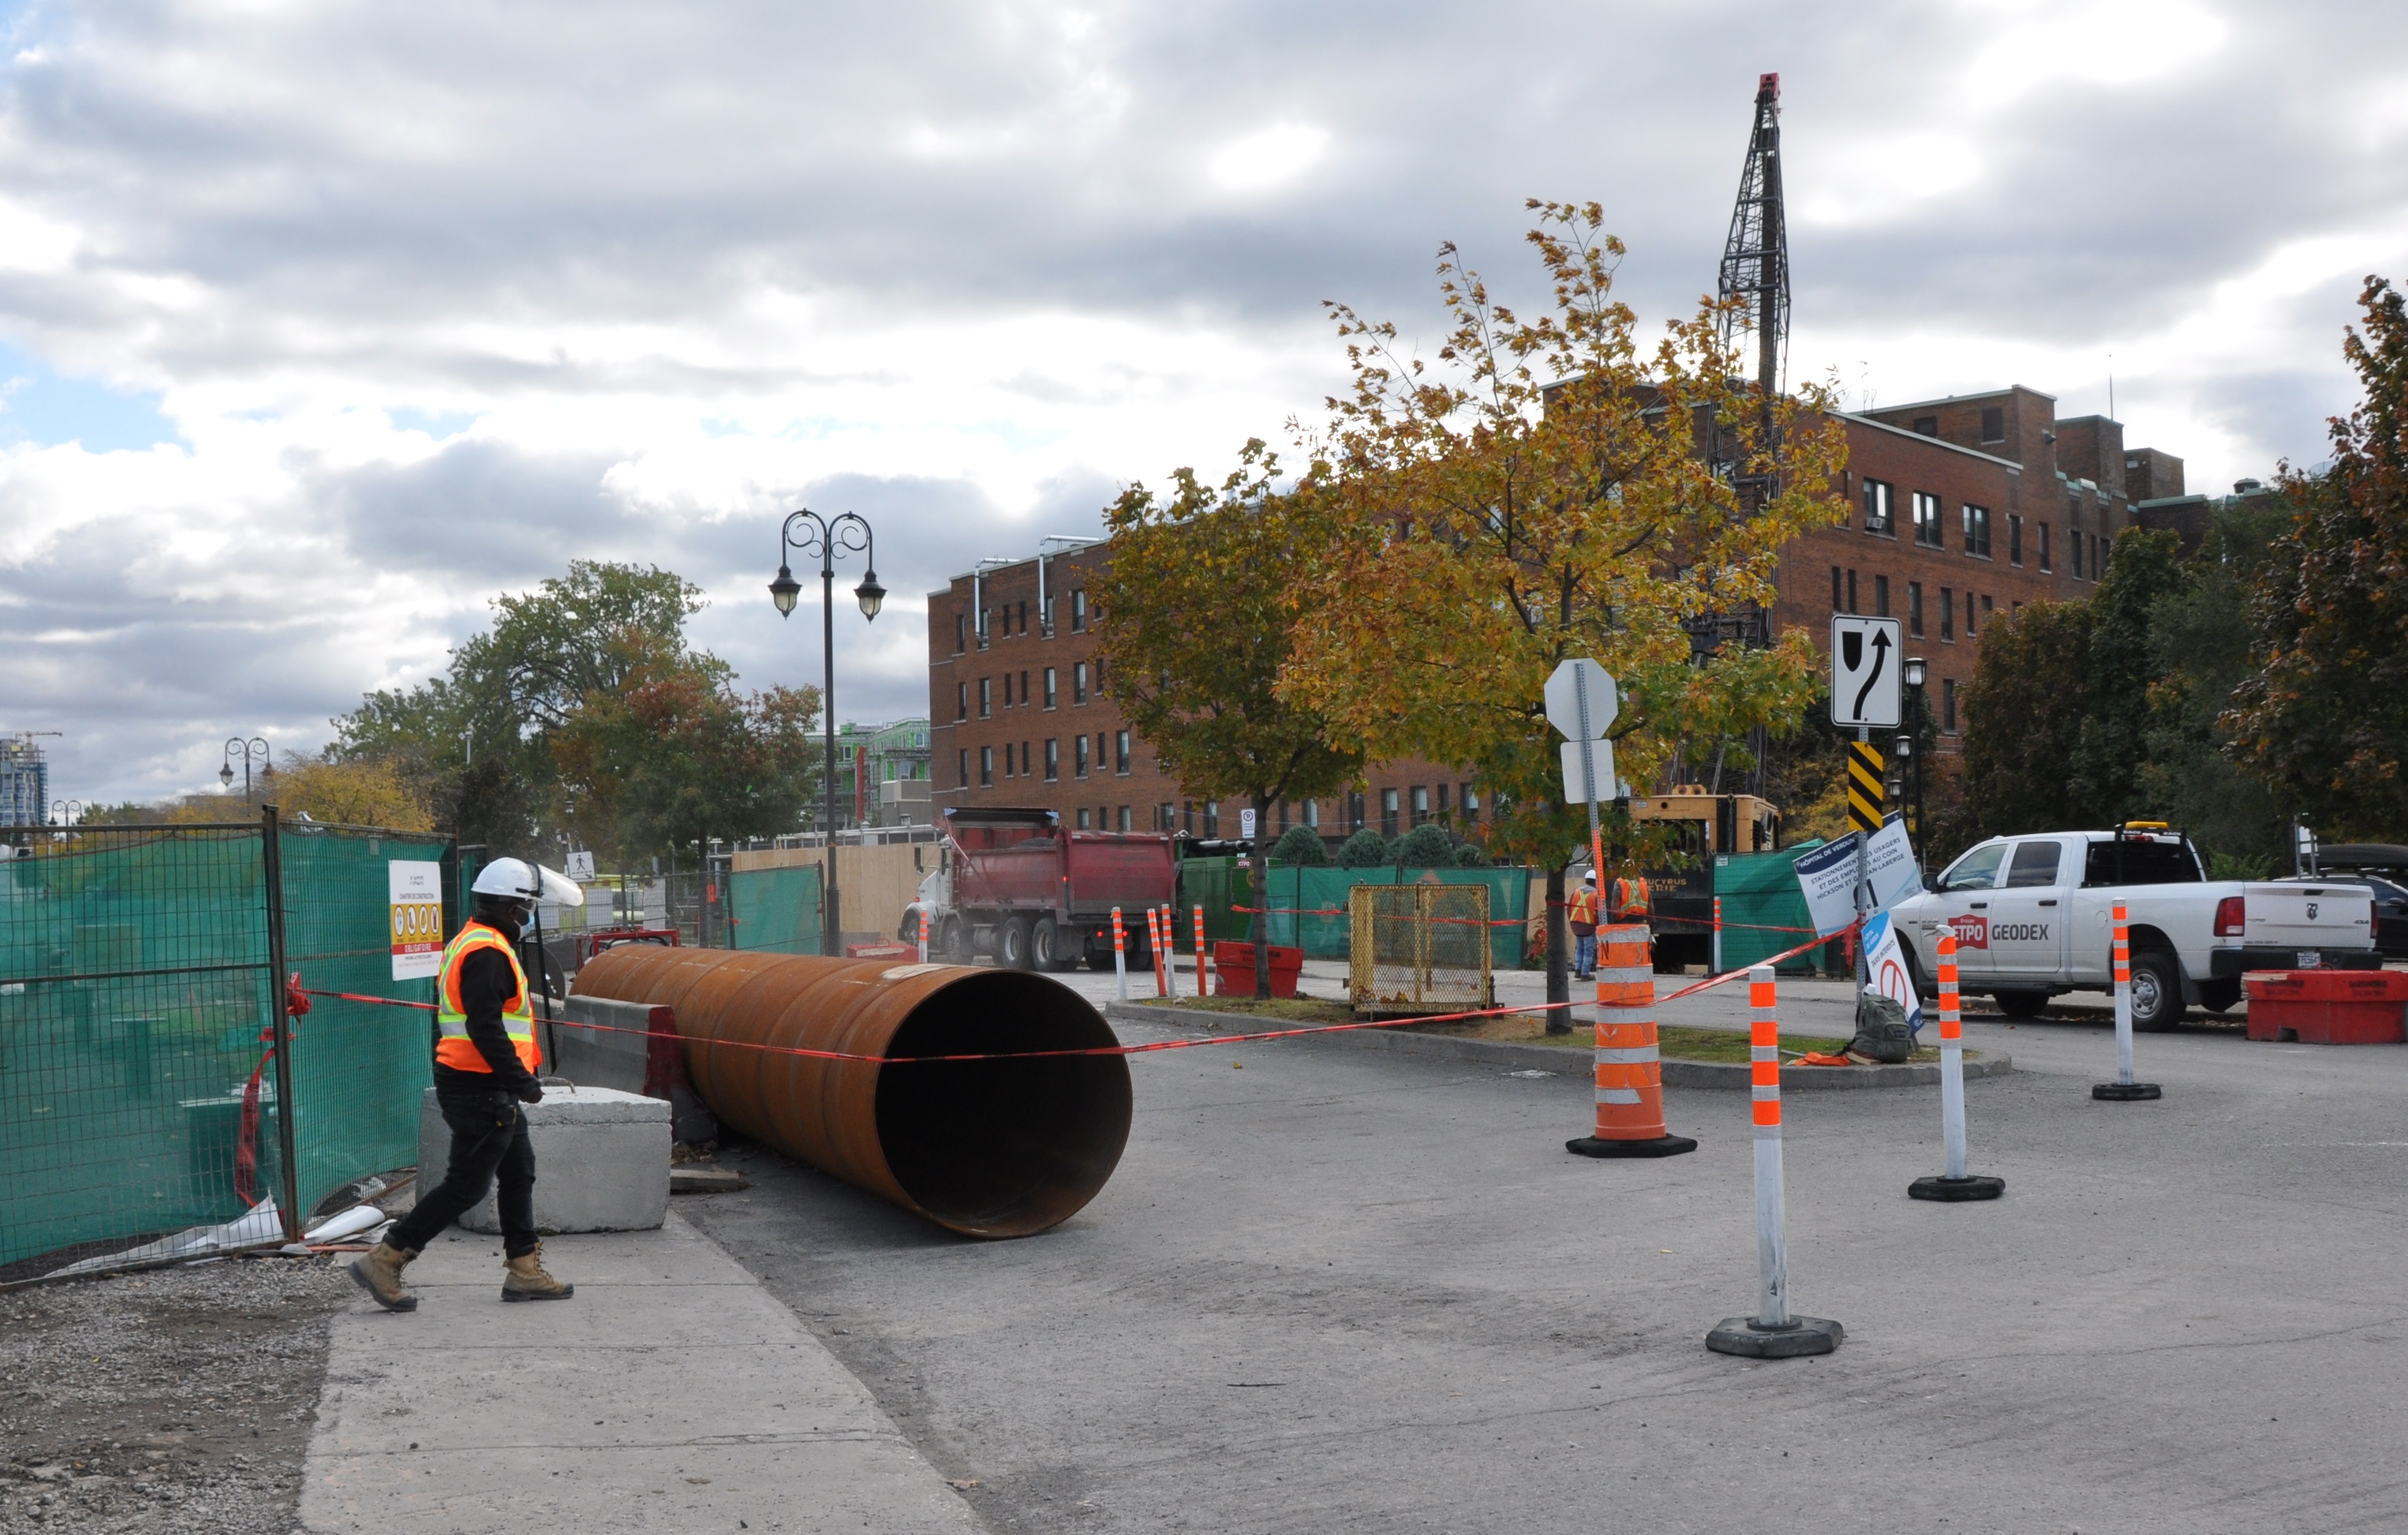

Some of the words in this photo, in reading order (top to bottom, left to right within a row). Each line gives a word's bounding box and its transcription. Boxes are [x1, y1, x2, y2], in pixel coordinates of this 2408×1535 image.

[1800, 852, 1824, 868] HÔPITAL
[1823, 848, 1832, 857] DE
[1831, 837, 1855, 852] VERDUN
[1874, 837, 1900, 853] USAGERS
[1818, 882, 1826, 890] ET
[1827, 876, 1840, 885] DES
[1840, 860, 1871, 879] EMPLOS
[1873, 855, 1881, 863] AU
[1882, 847, 1898, 858] COIN
[1645, 878, 1687, 887] UCYRUS
[1816, 883, 1844, 900] HICKSON
[1844, 878, 1852, 886] ET
[1992, 924, 2049, 941] GEODEX
[405, 943, 431, 953] OBLIGATOIRE
